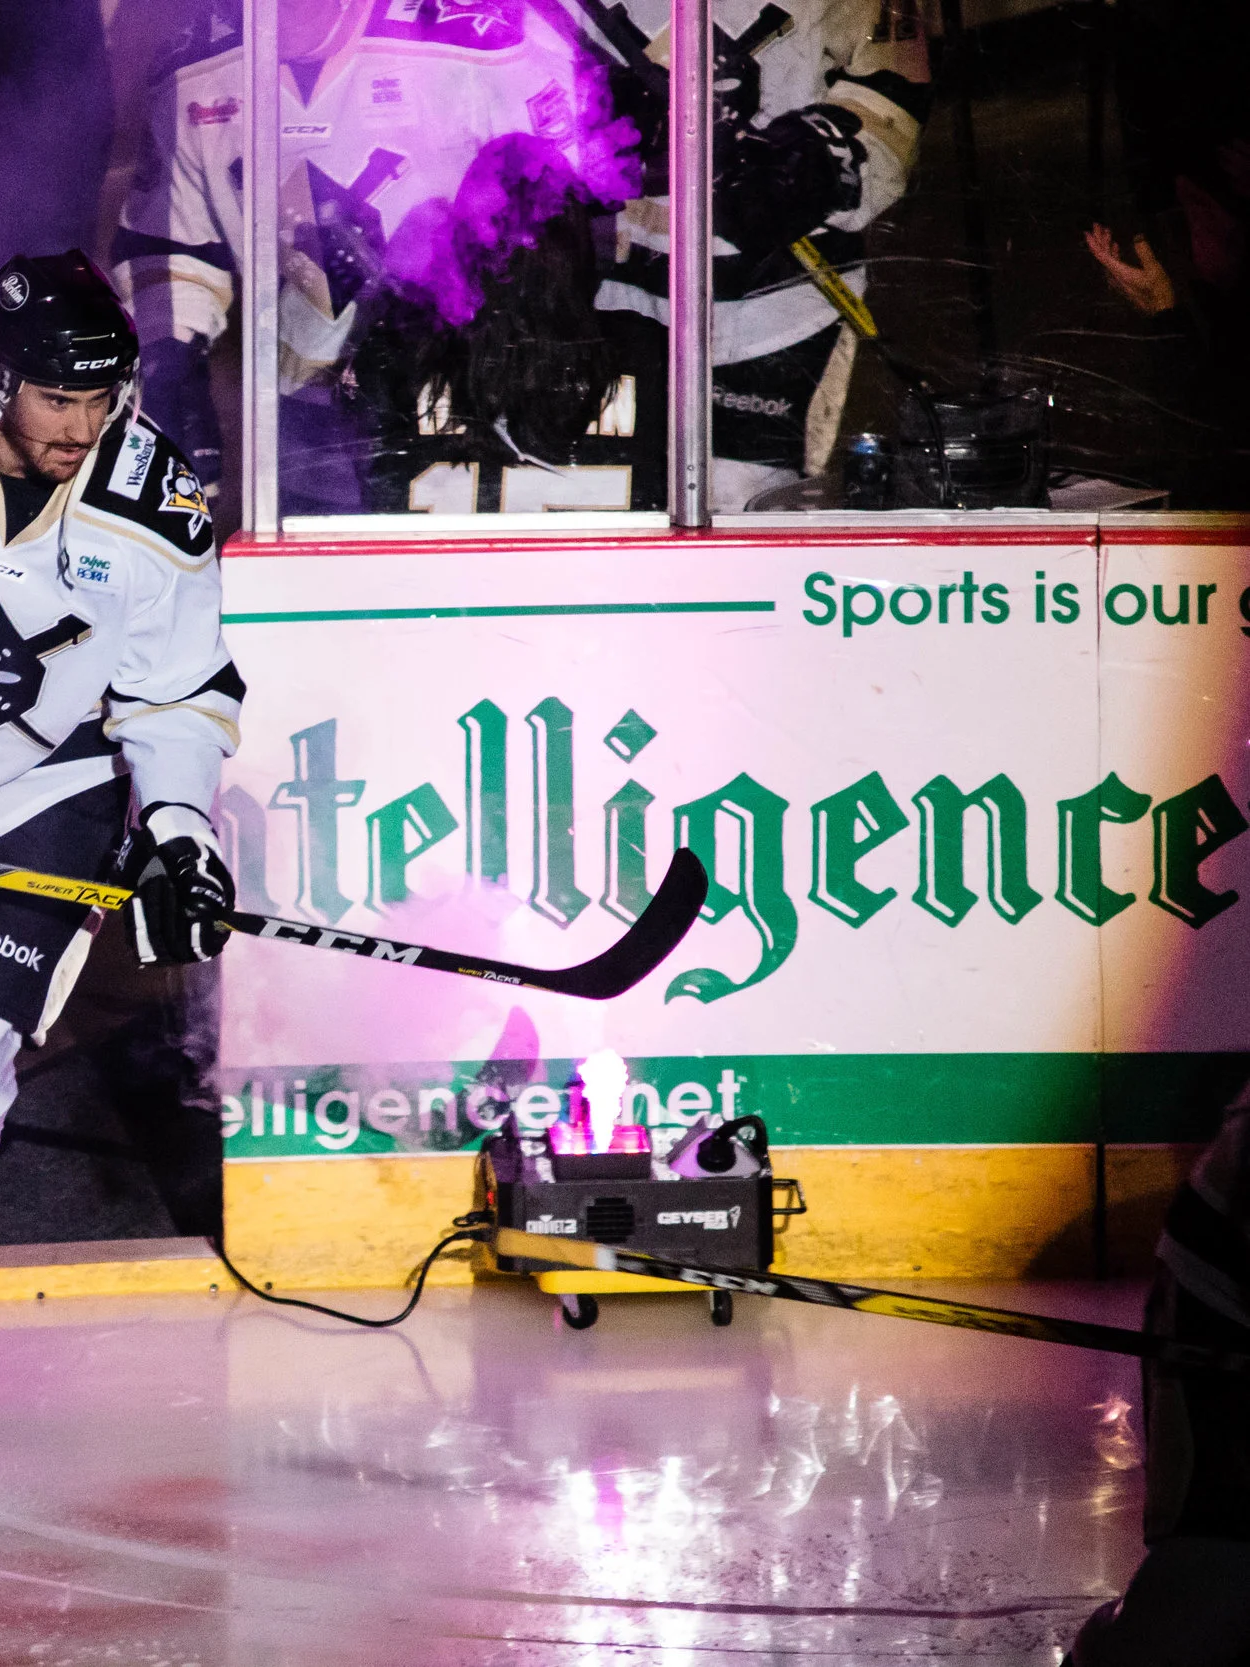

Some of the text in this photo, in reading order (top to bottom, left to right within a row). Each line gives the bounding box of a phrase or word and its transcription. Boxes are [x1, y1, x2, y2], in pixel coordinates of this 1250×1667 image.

[73, 356, 118, 370] CCM
[803, 571, 1010, 638] Sports
[1035, 571, 1080, 624] is
[1104, 583, 1217, 626] our
[27, 881, 74, 895] SUPER
[259, 917, 423, 965] CCM
[657, 1210, 728, 1225] GEYSER
[679, 1267, 778, 1296] CCM
